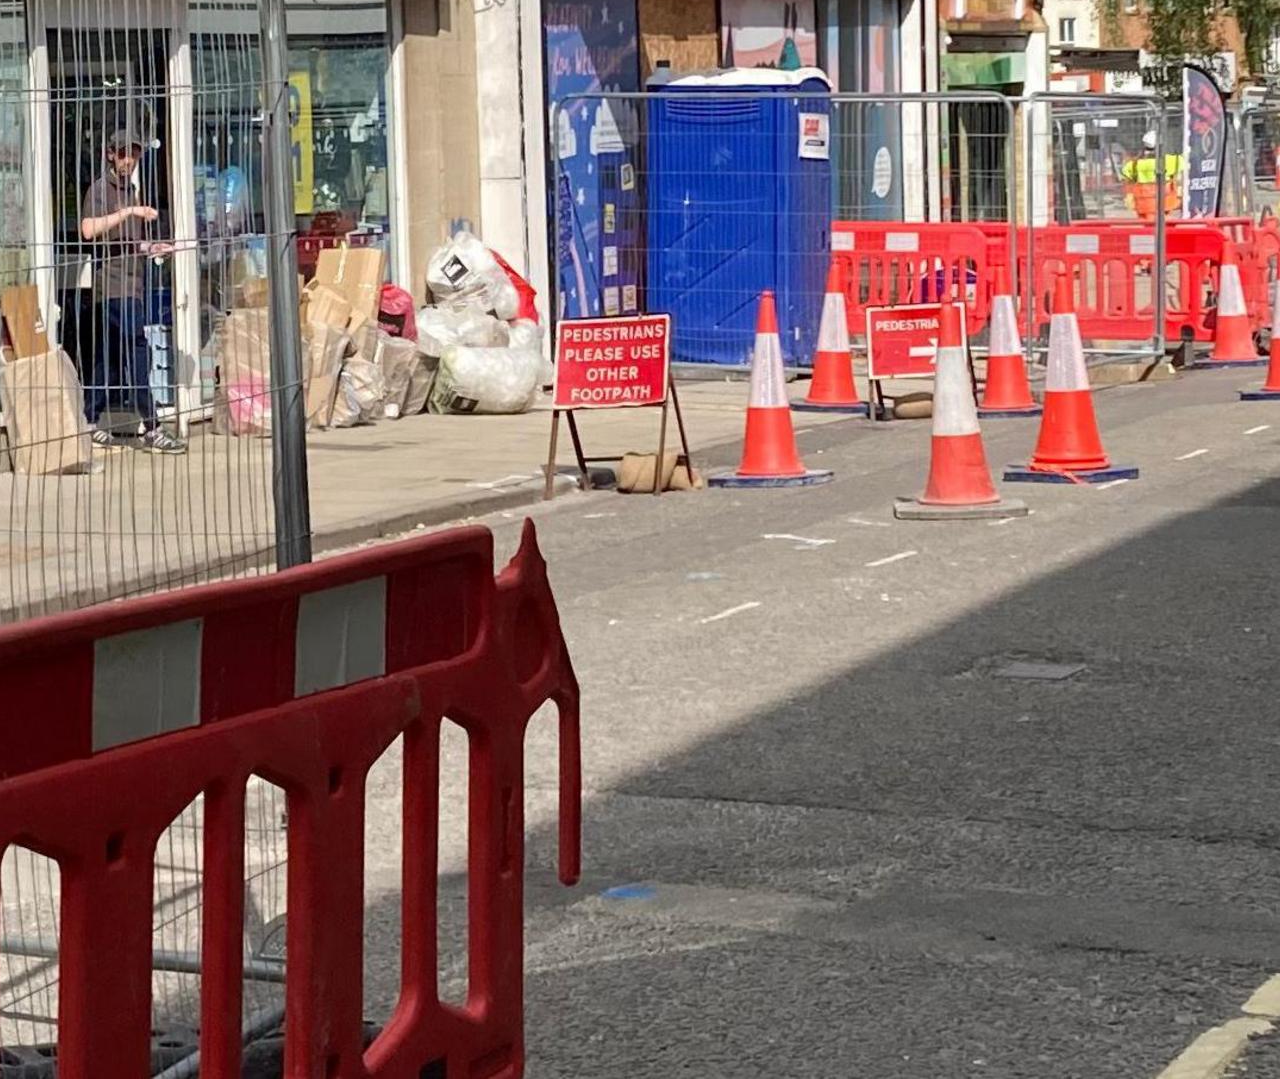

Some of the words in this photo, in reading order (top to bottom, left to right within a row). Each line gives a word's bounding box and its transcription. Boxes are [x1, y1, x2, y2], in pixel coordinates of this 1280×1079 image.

[875, 318, 939, 331] PEDESTRIA
[563, 324, 664, 343] PEDESTRIANS
[565, 347, 624, 362] PLEASE
[630, 344, 661, 359] USE
[586, 366, 638, 381] OTHER
[570, 385, 651, 401] FOOTPATH
